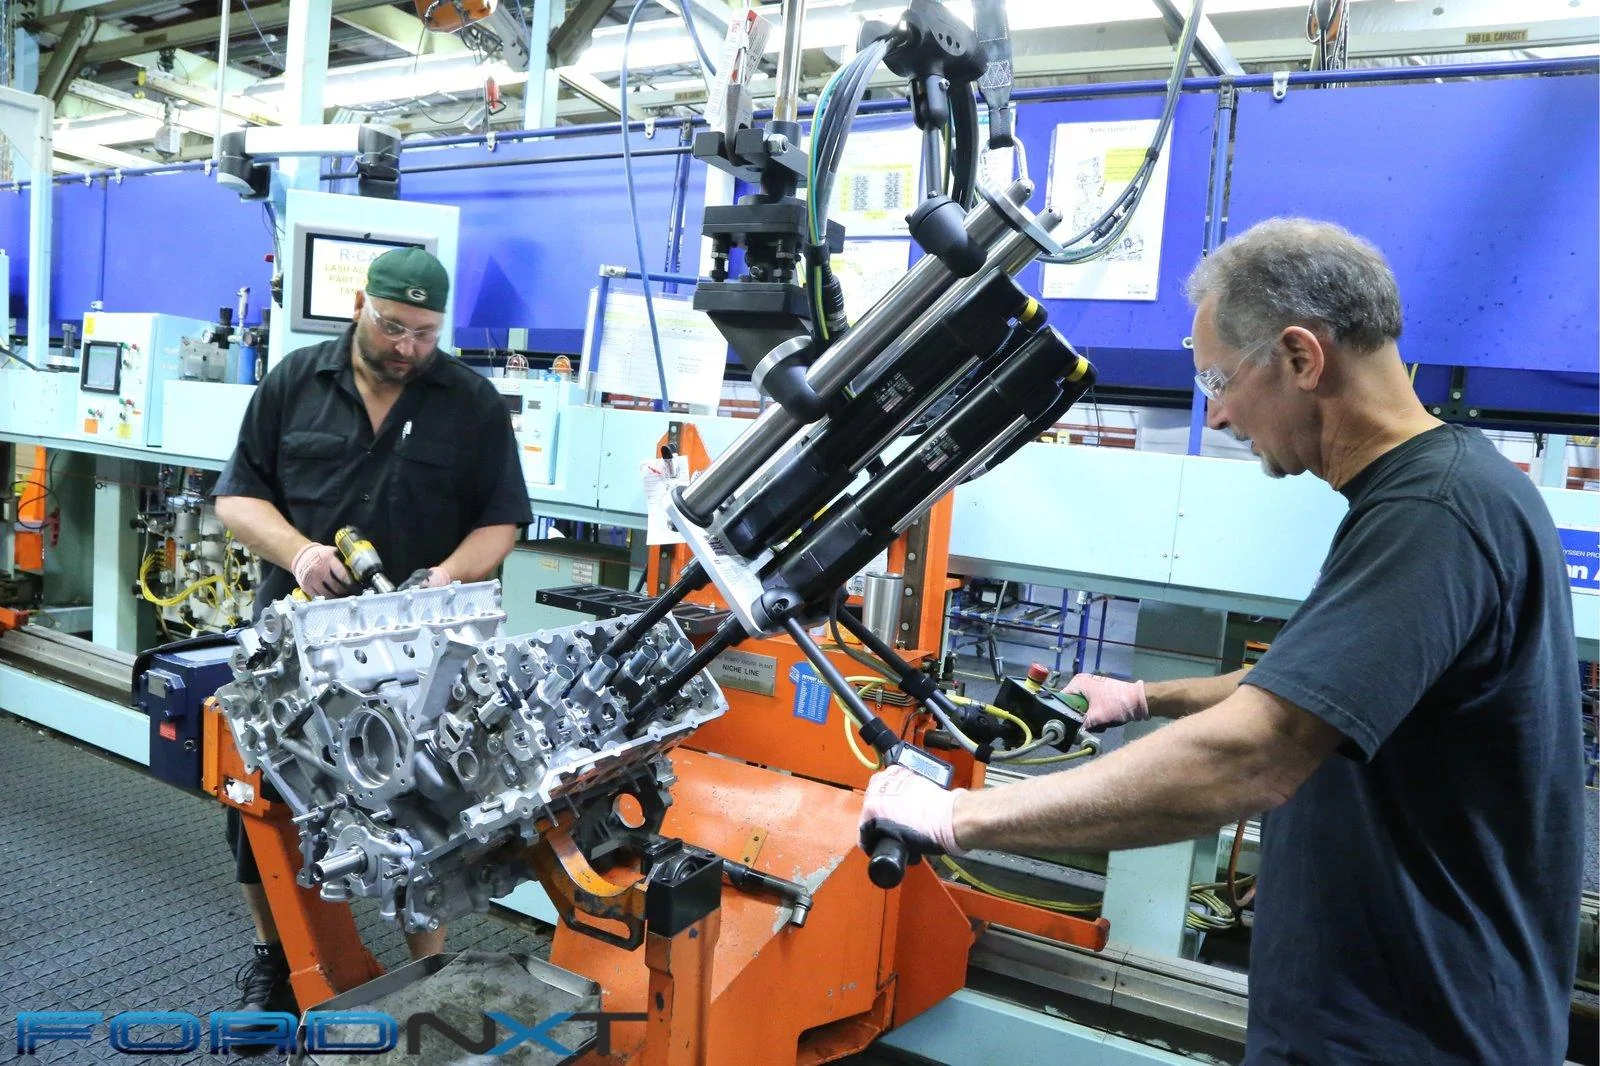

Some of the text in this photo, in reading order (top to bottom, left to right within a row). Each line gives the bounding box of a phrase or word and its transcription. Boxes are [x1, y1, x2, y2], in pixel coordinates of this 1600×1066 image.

[542, 594, 691, 631] 5 4 3 1
[722, 664, 760, 677] NICHE LINE
